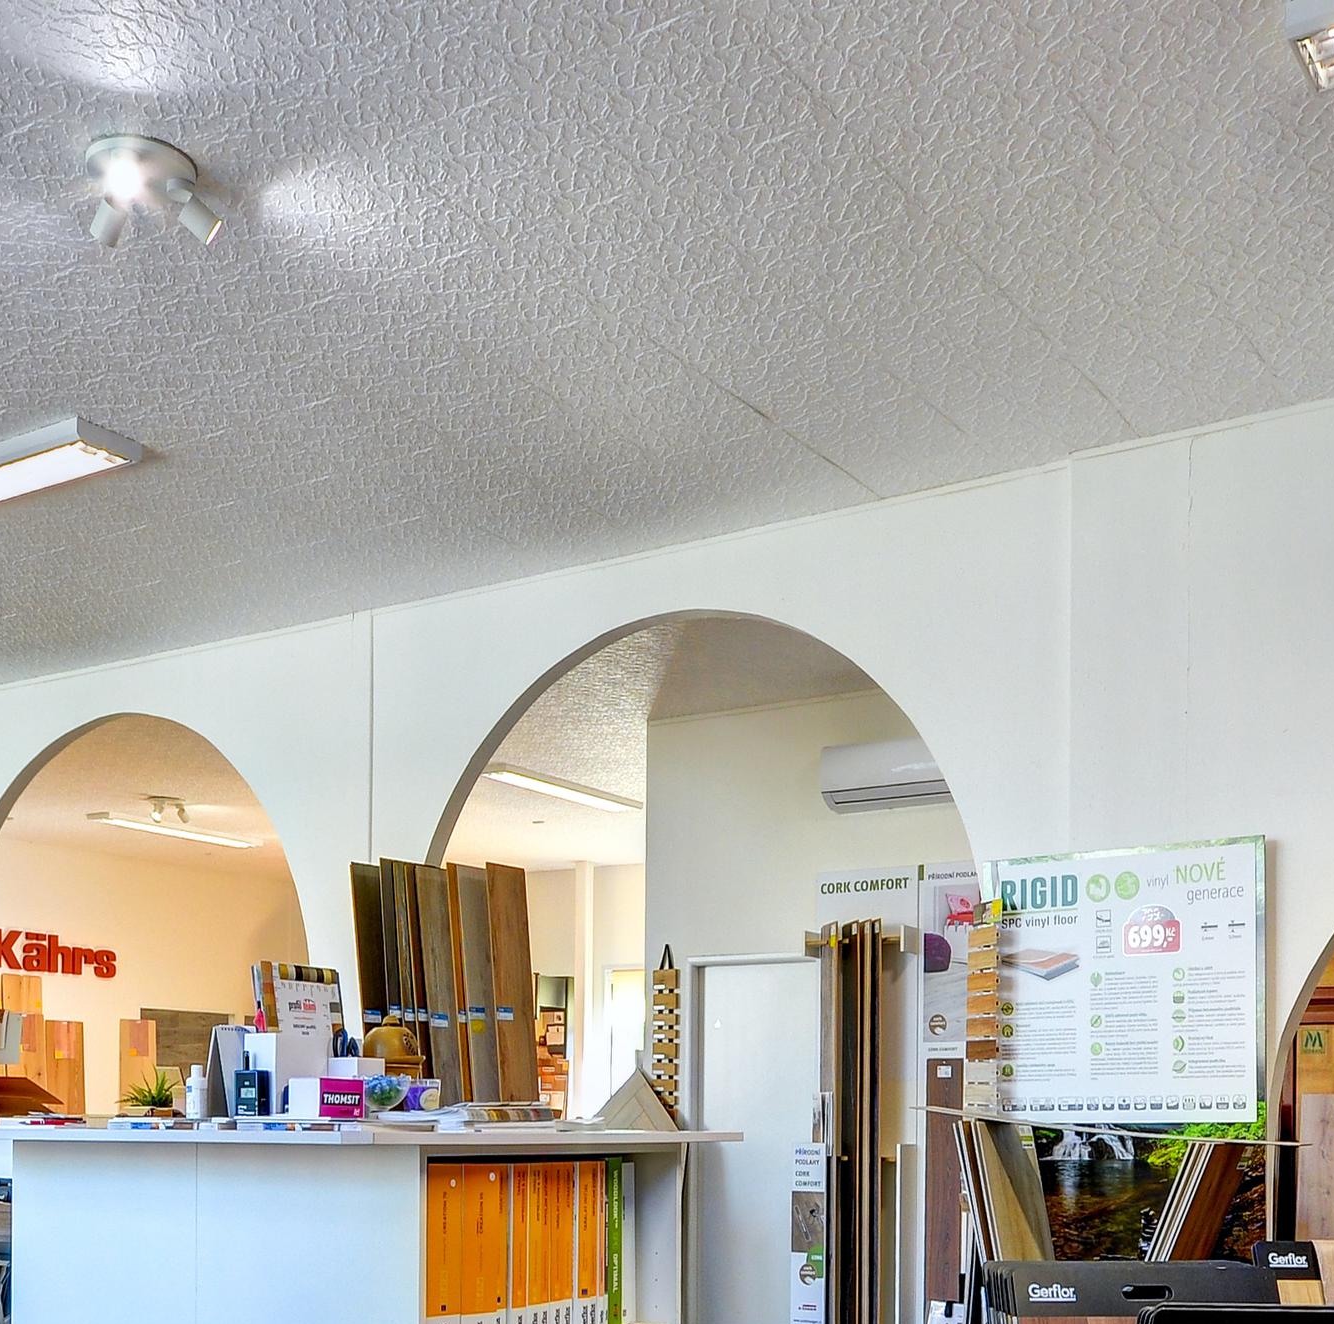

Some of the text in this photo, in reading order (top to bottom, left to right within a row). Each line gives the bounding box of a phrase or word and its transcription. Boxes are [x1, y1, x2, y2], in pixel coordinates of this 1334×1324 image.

[927, 871, 955, 881] PŘÍRODNÍ
[1147, 857, 1227, 889] vinyl NOVÉ
[820, 877, 909, 895] CORK COMFORT
[1001, 874, 1079, 912] RIGID
[1186, 885, 1245, 905] generace
[1001, 914, 1079, 929] SPC vinyl floor
[323, 1092, 361, 1105] THOMSIT
[1268, 1252, 1309, 1266] Gerflor
[1027, 1283, 1077, 1299] Gerflor
